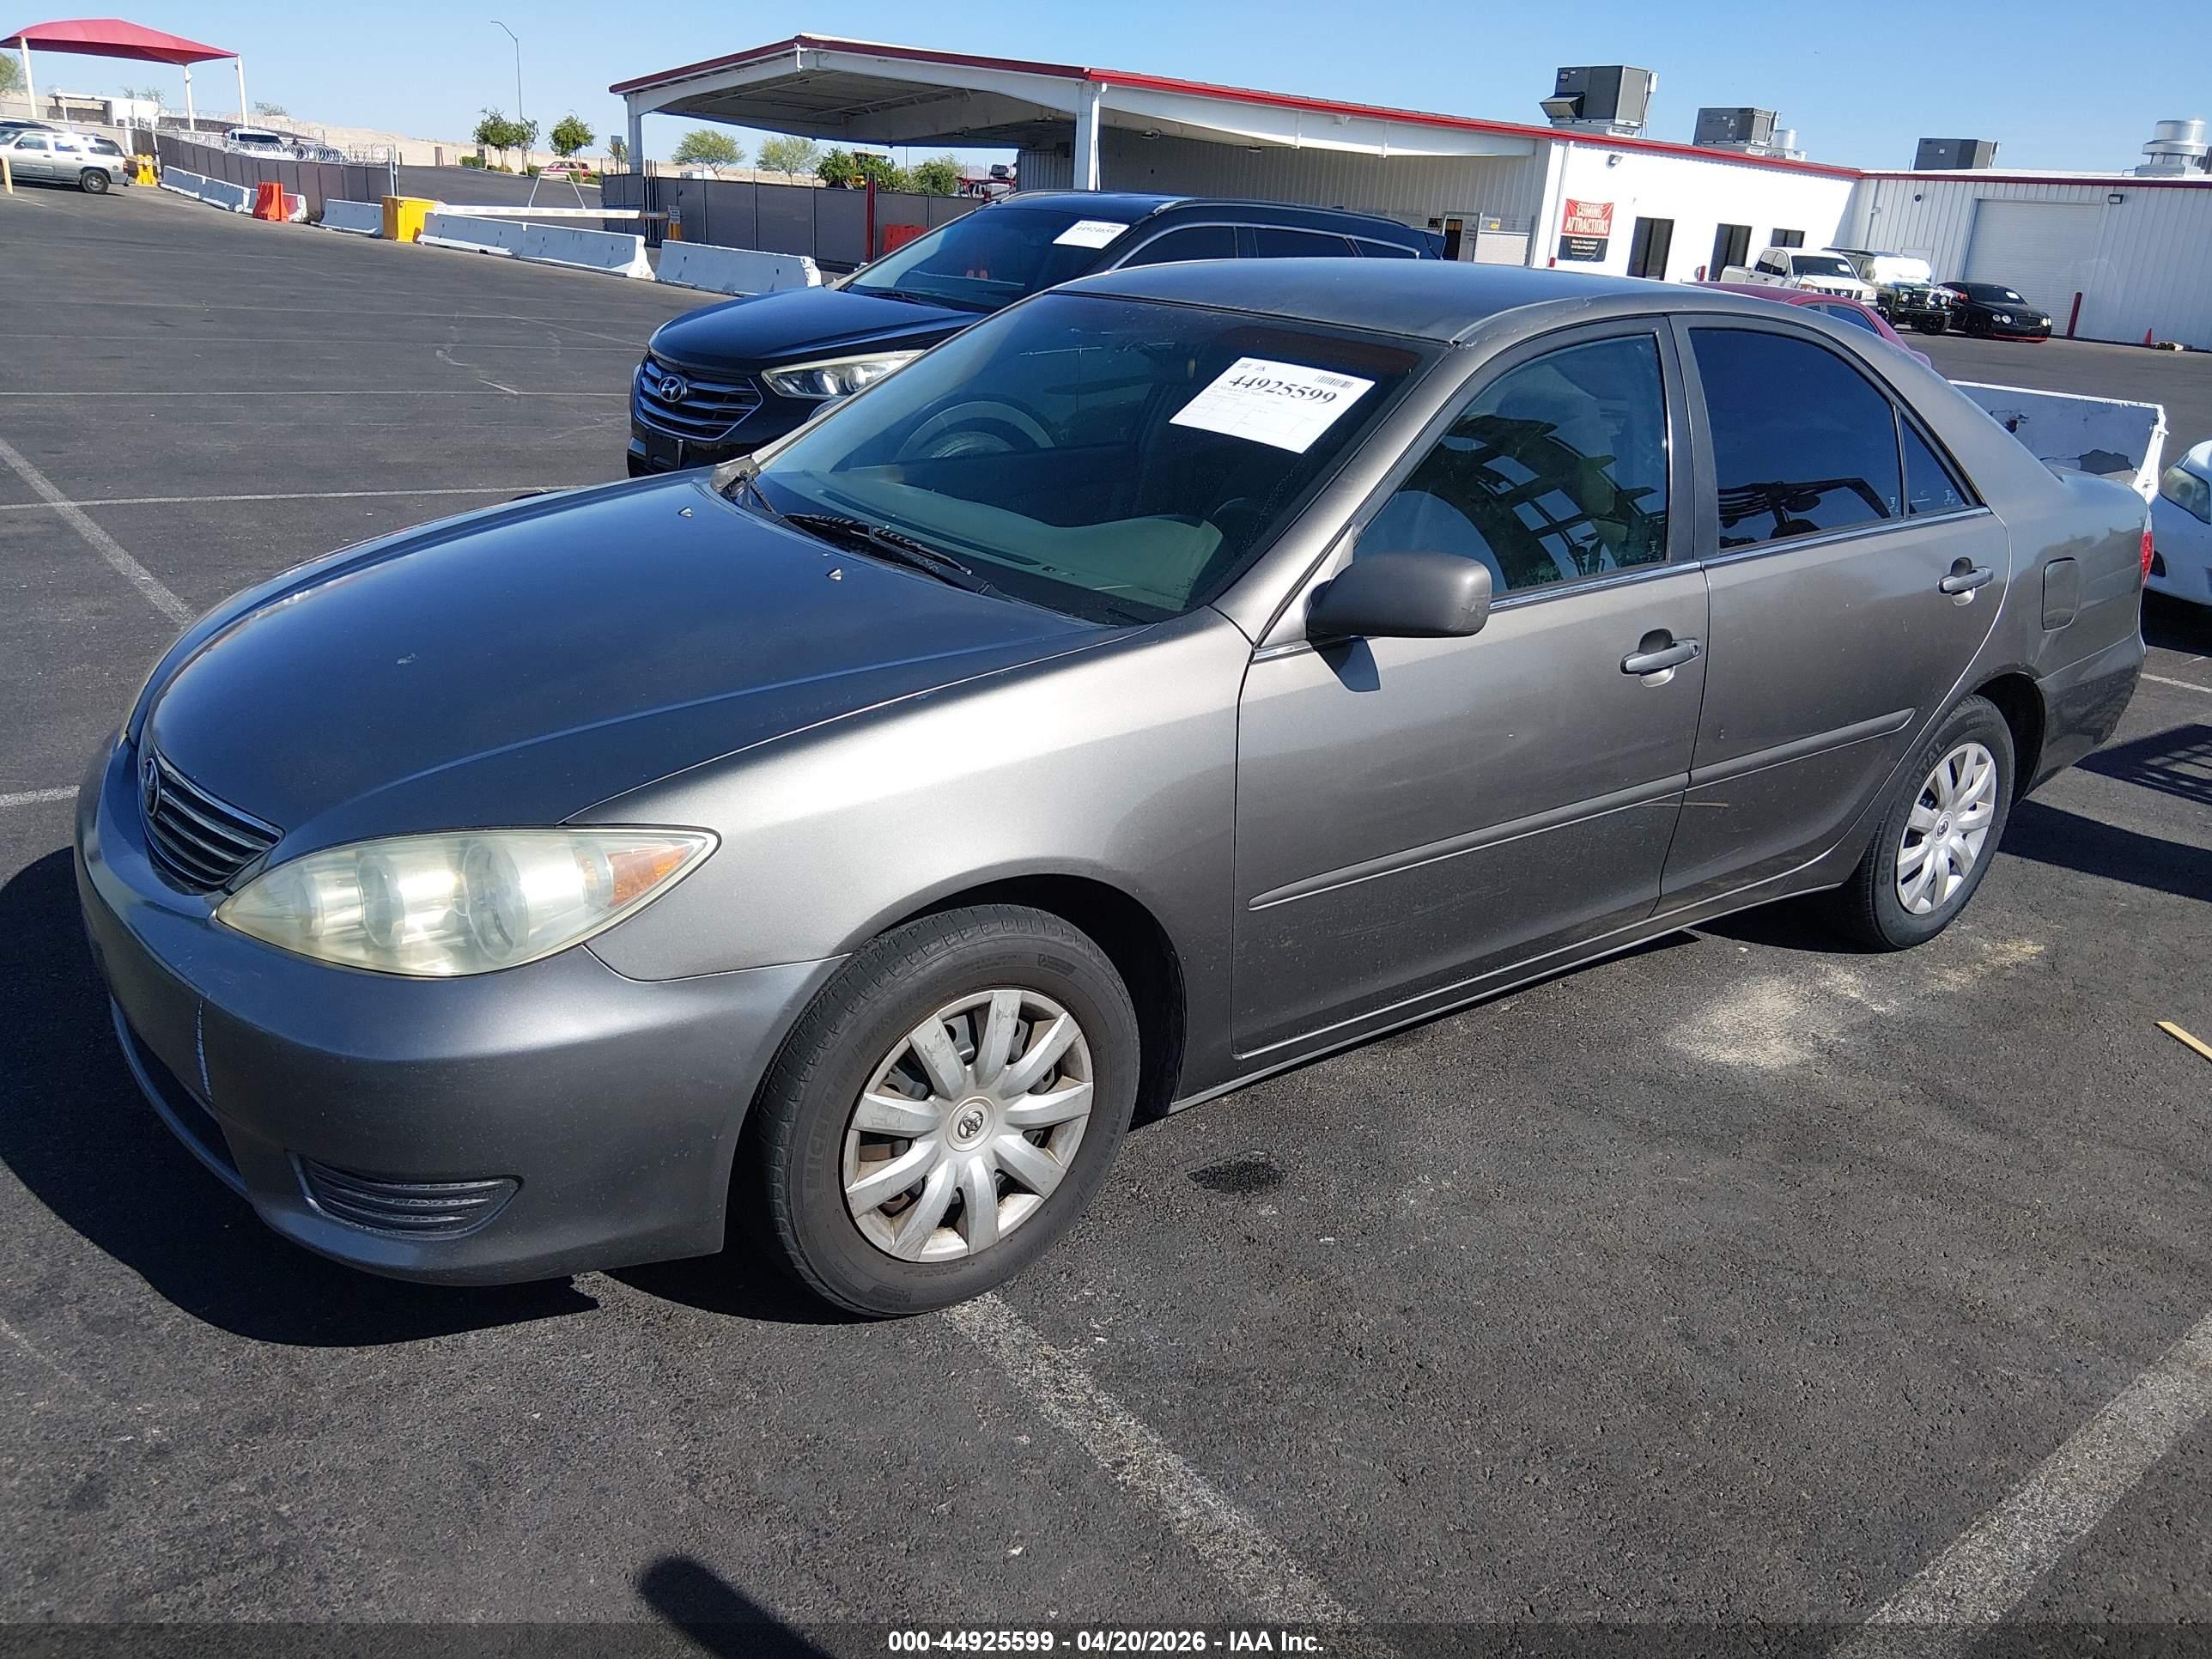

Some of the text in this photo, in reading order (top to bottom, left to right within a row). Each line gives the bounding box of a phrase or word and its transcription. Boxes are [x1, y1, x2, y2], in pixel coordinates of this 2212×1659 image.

[1577, 204, 1602, 217] COMING
[1565, 216, 1609, 234] ATTRACTIONS
[1230, 374, 1337, 404] 44925599
